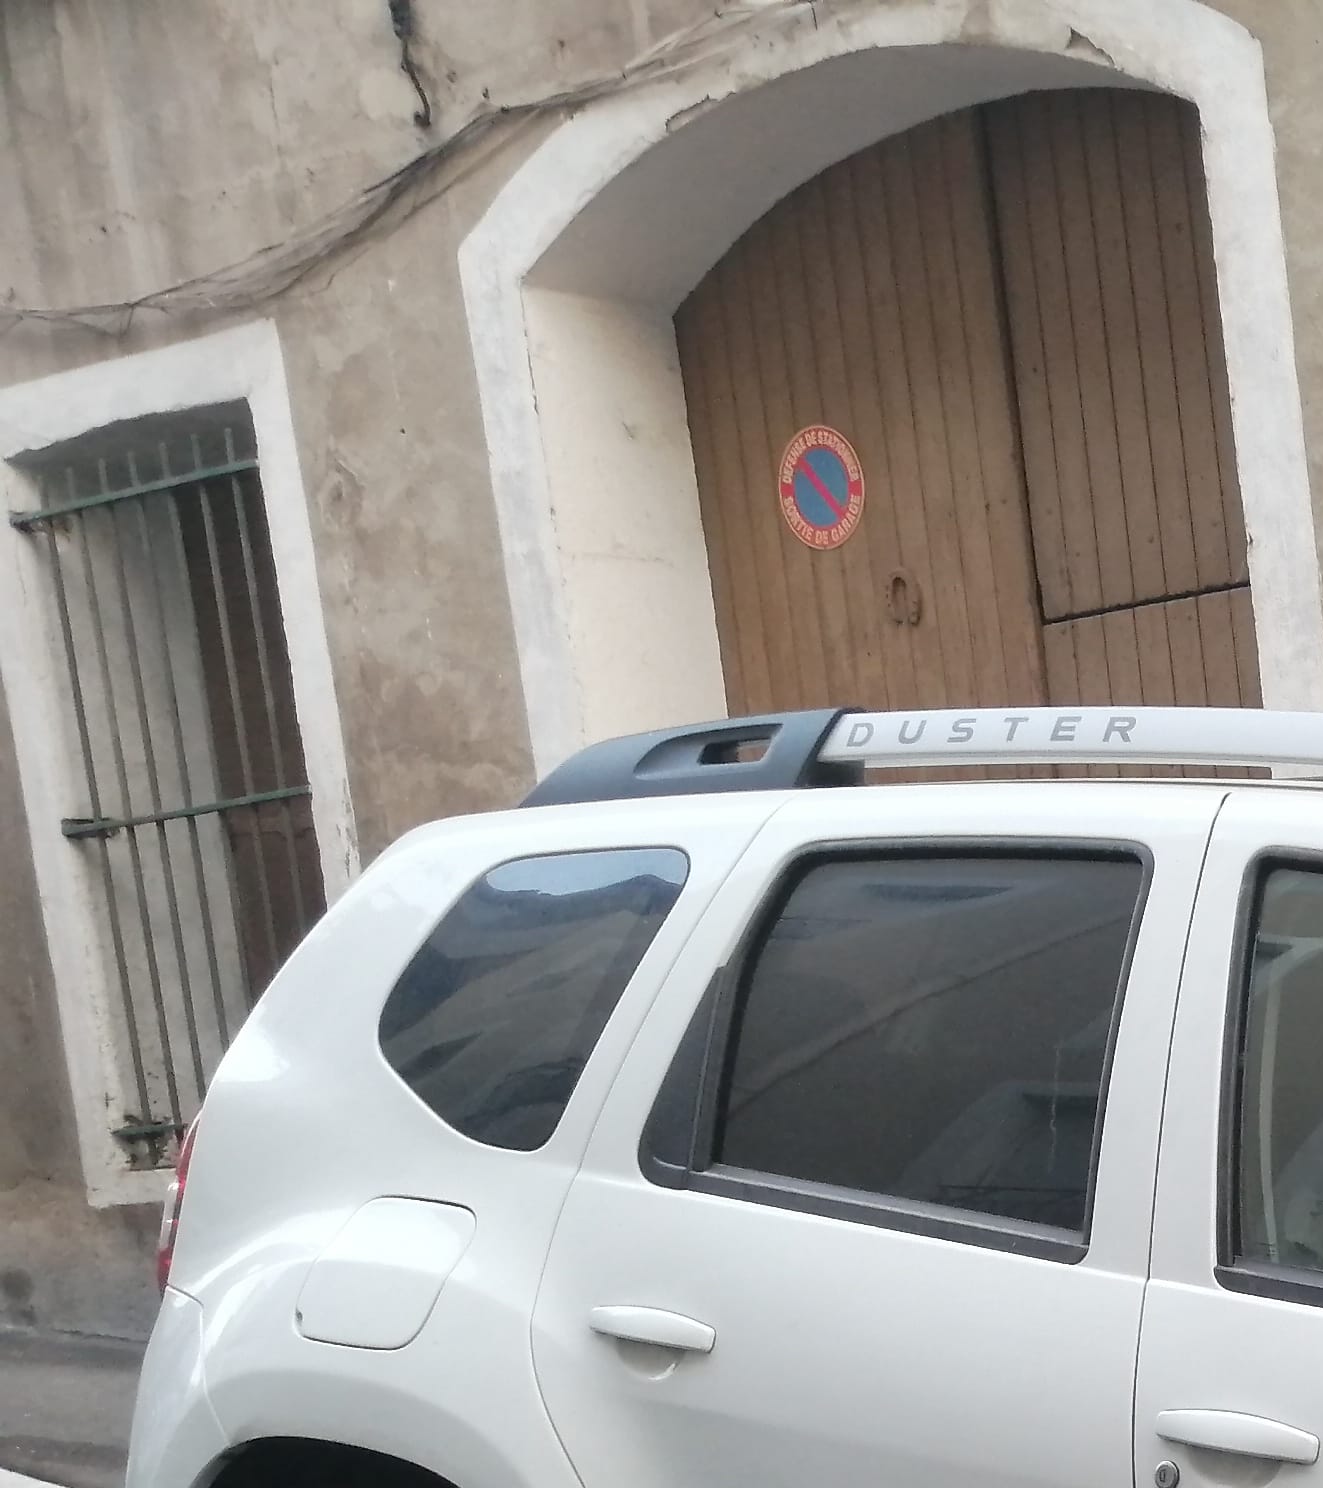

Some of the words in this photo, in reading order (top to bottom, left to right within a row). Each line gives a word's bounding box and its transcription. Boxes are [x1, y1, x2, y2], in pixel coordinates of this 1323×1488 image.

[782, 437, 807, 484] DEFENSE
[804, 431, 818, 447] DE
[783, 495, 814, 542] SORTIE
[815, 530, 829, 545] DE
[831, 494, 860, 542] GARAGE
[846, 716, 1137, 748] DUSTER
